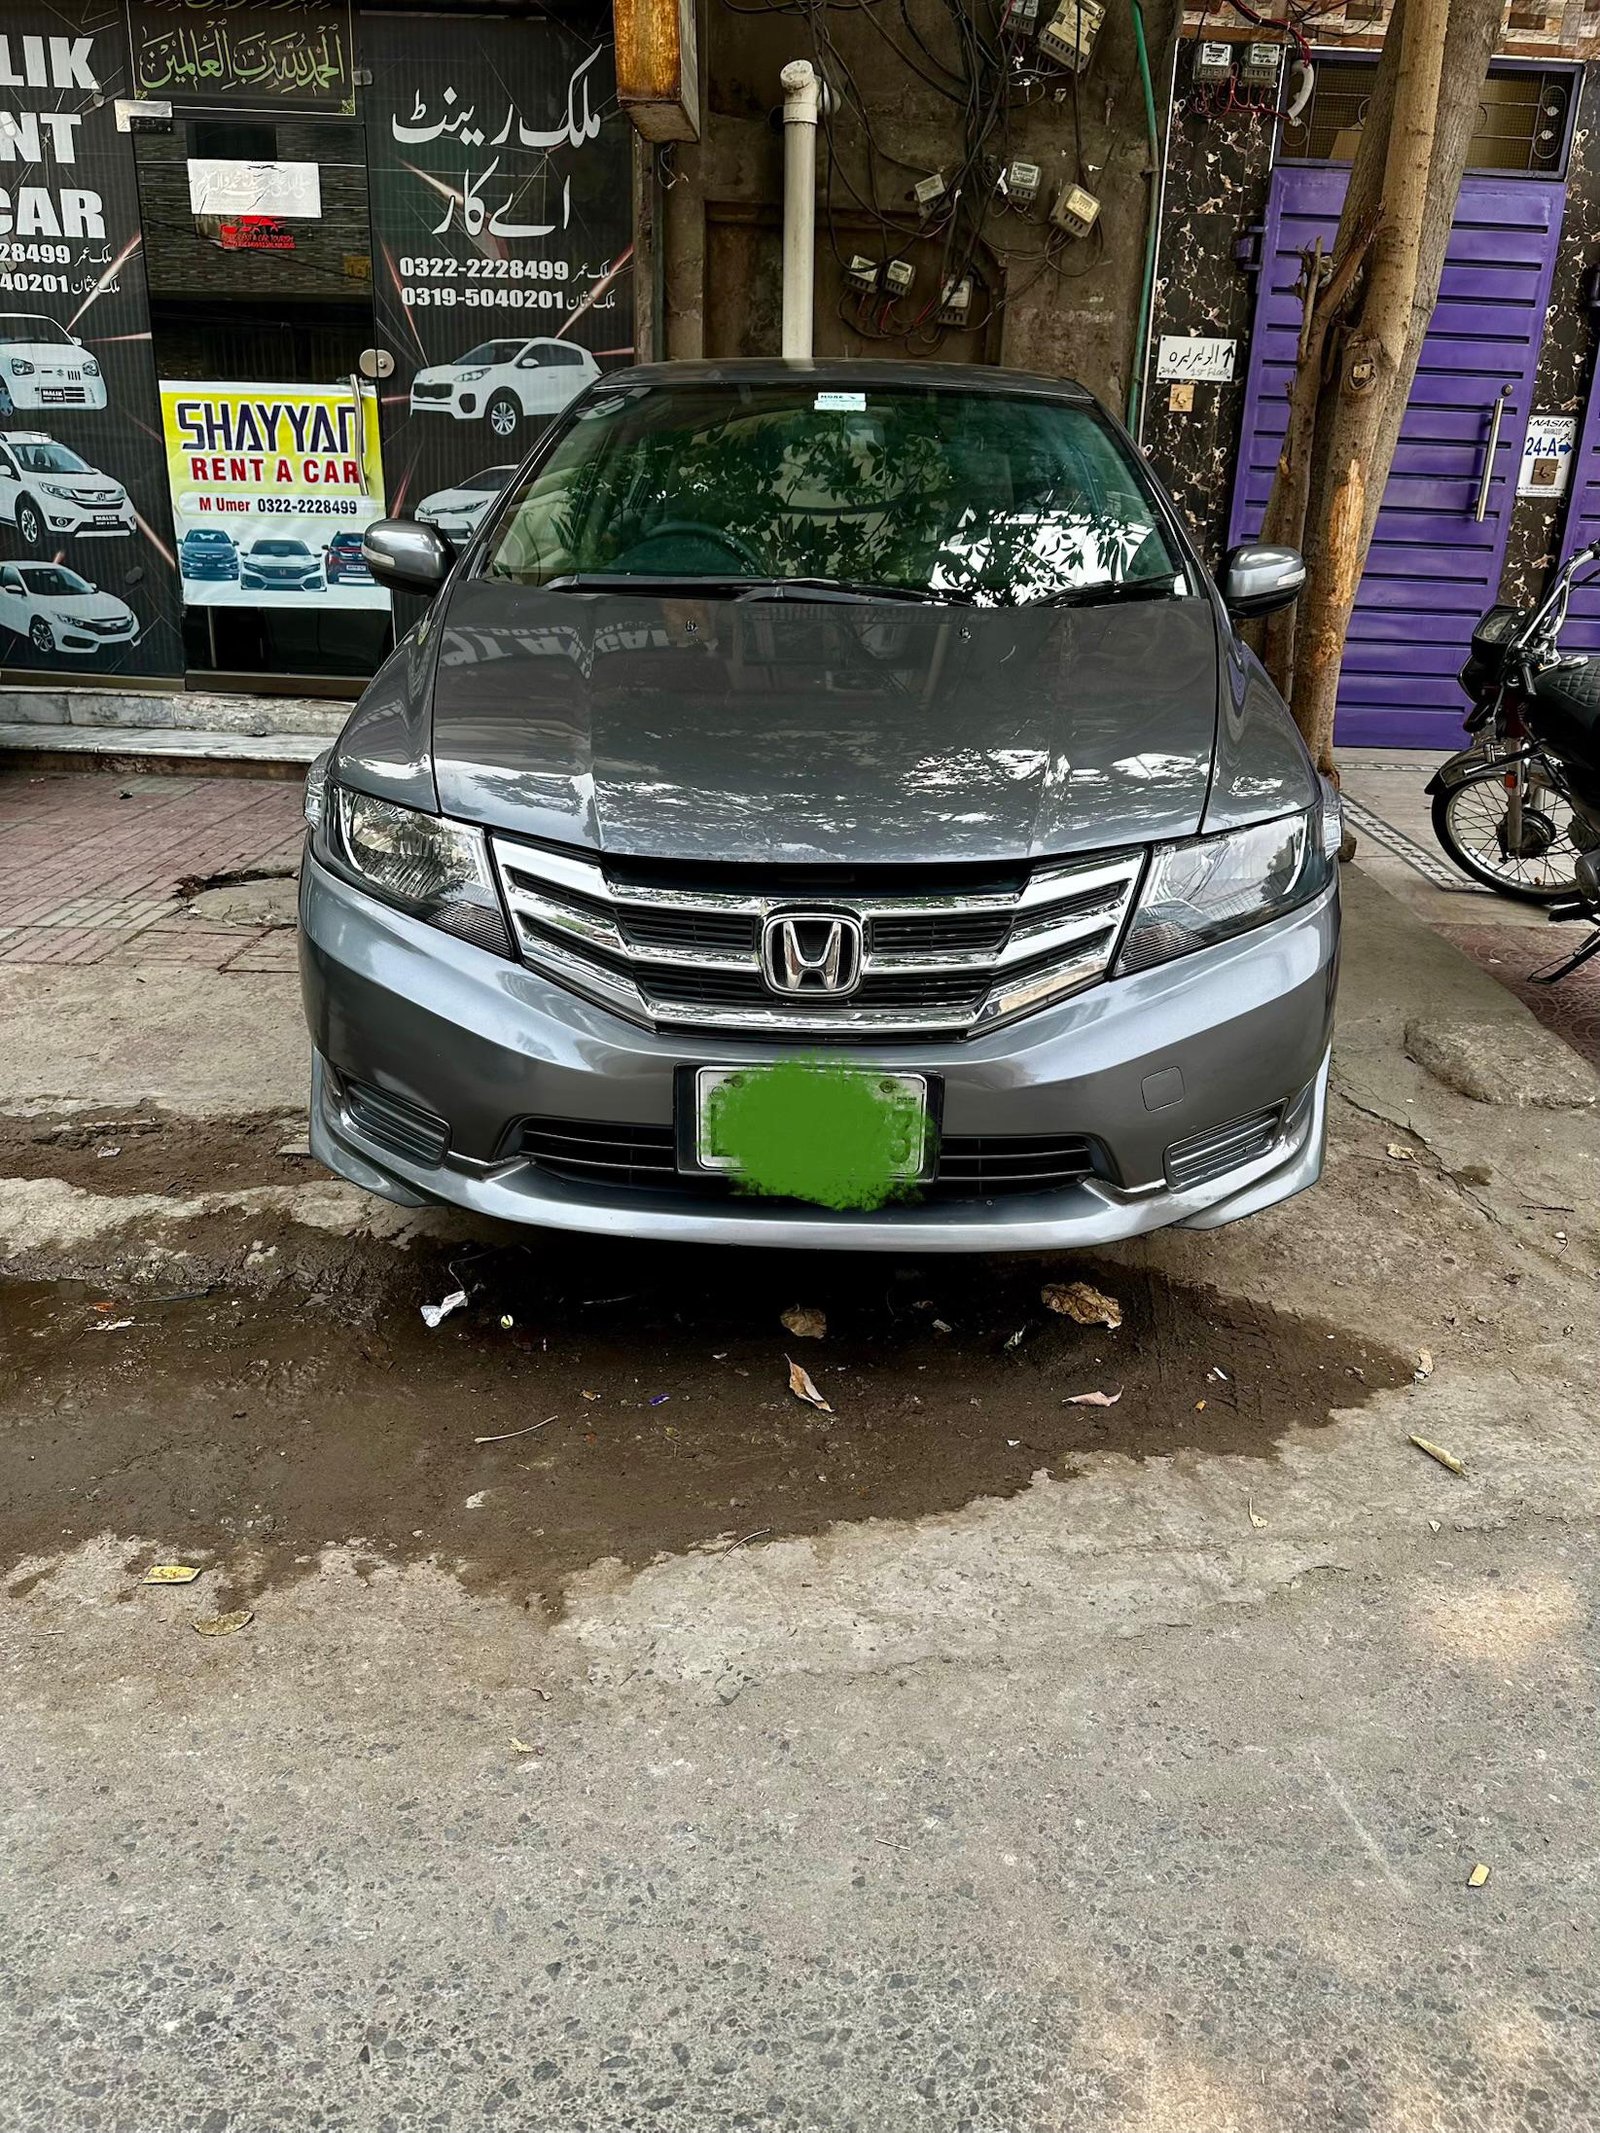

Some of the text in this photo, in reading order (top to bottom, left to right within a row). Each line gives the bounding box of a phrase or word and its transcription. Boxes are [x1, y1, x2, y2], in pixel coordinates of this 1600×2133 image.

[399, 257, 569, 280] 0322-2228499
[401, 287, 564, 309] 0319-5040201
[1533, 420, 1571, 428] NASIR
[1525, 438, 1557, 456] 24-A
[191, 457, 360, 484] RENT A CAR
[199, 497, 357, 514] M Umer 0322-2228499
